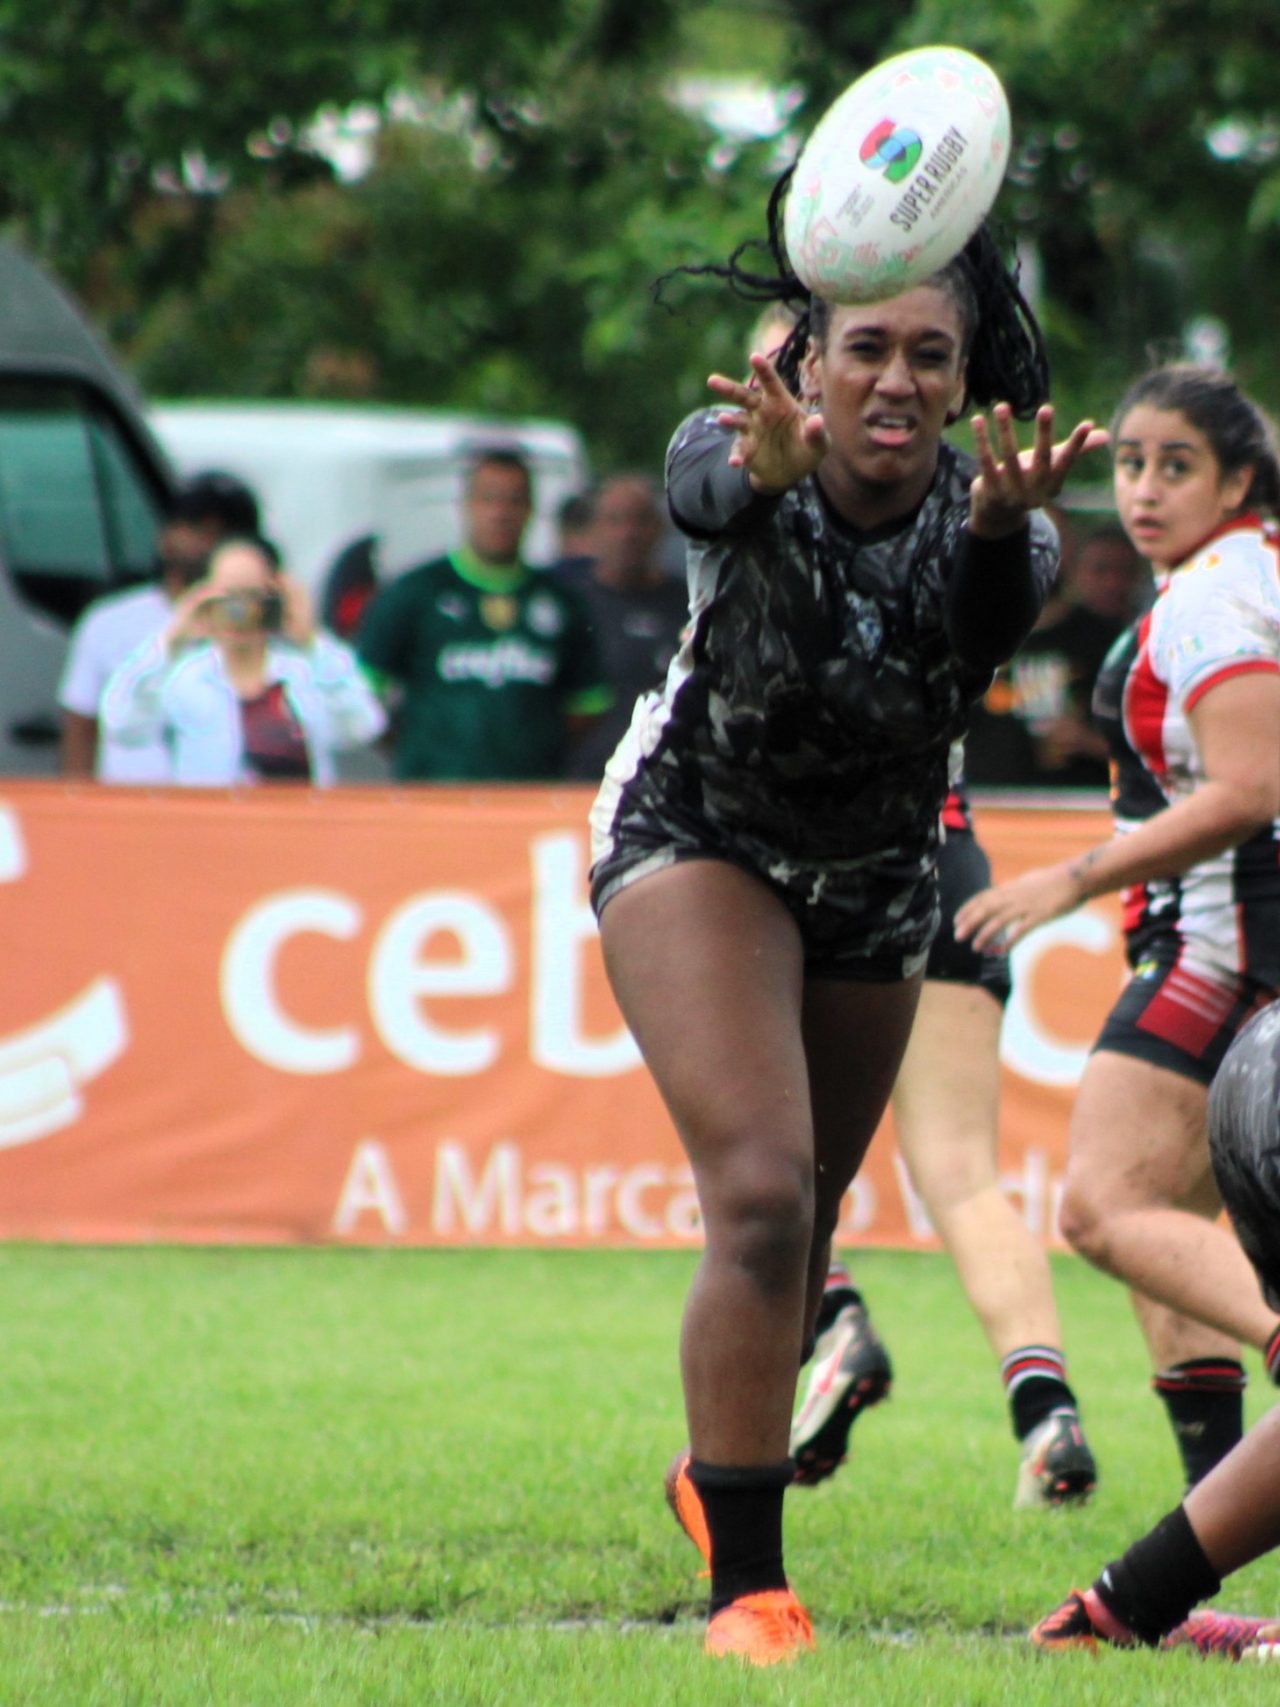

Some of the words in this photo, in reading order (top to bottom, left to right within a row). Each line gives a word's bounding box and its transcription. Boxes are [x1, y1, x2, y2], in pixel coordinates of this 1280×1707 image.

[889, 174, 938, 232] SUPER
[924, 126, 968, 184] RUGBY
[333, 1138, 406, 1237] A
